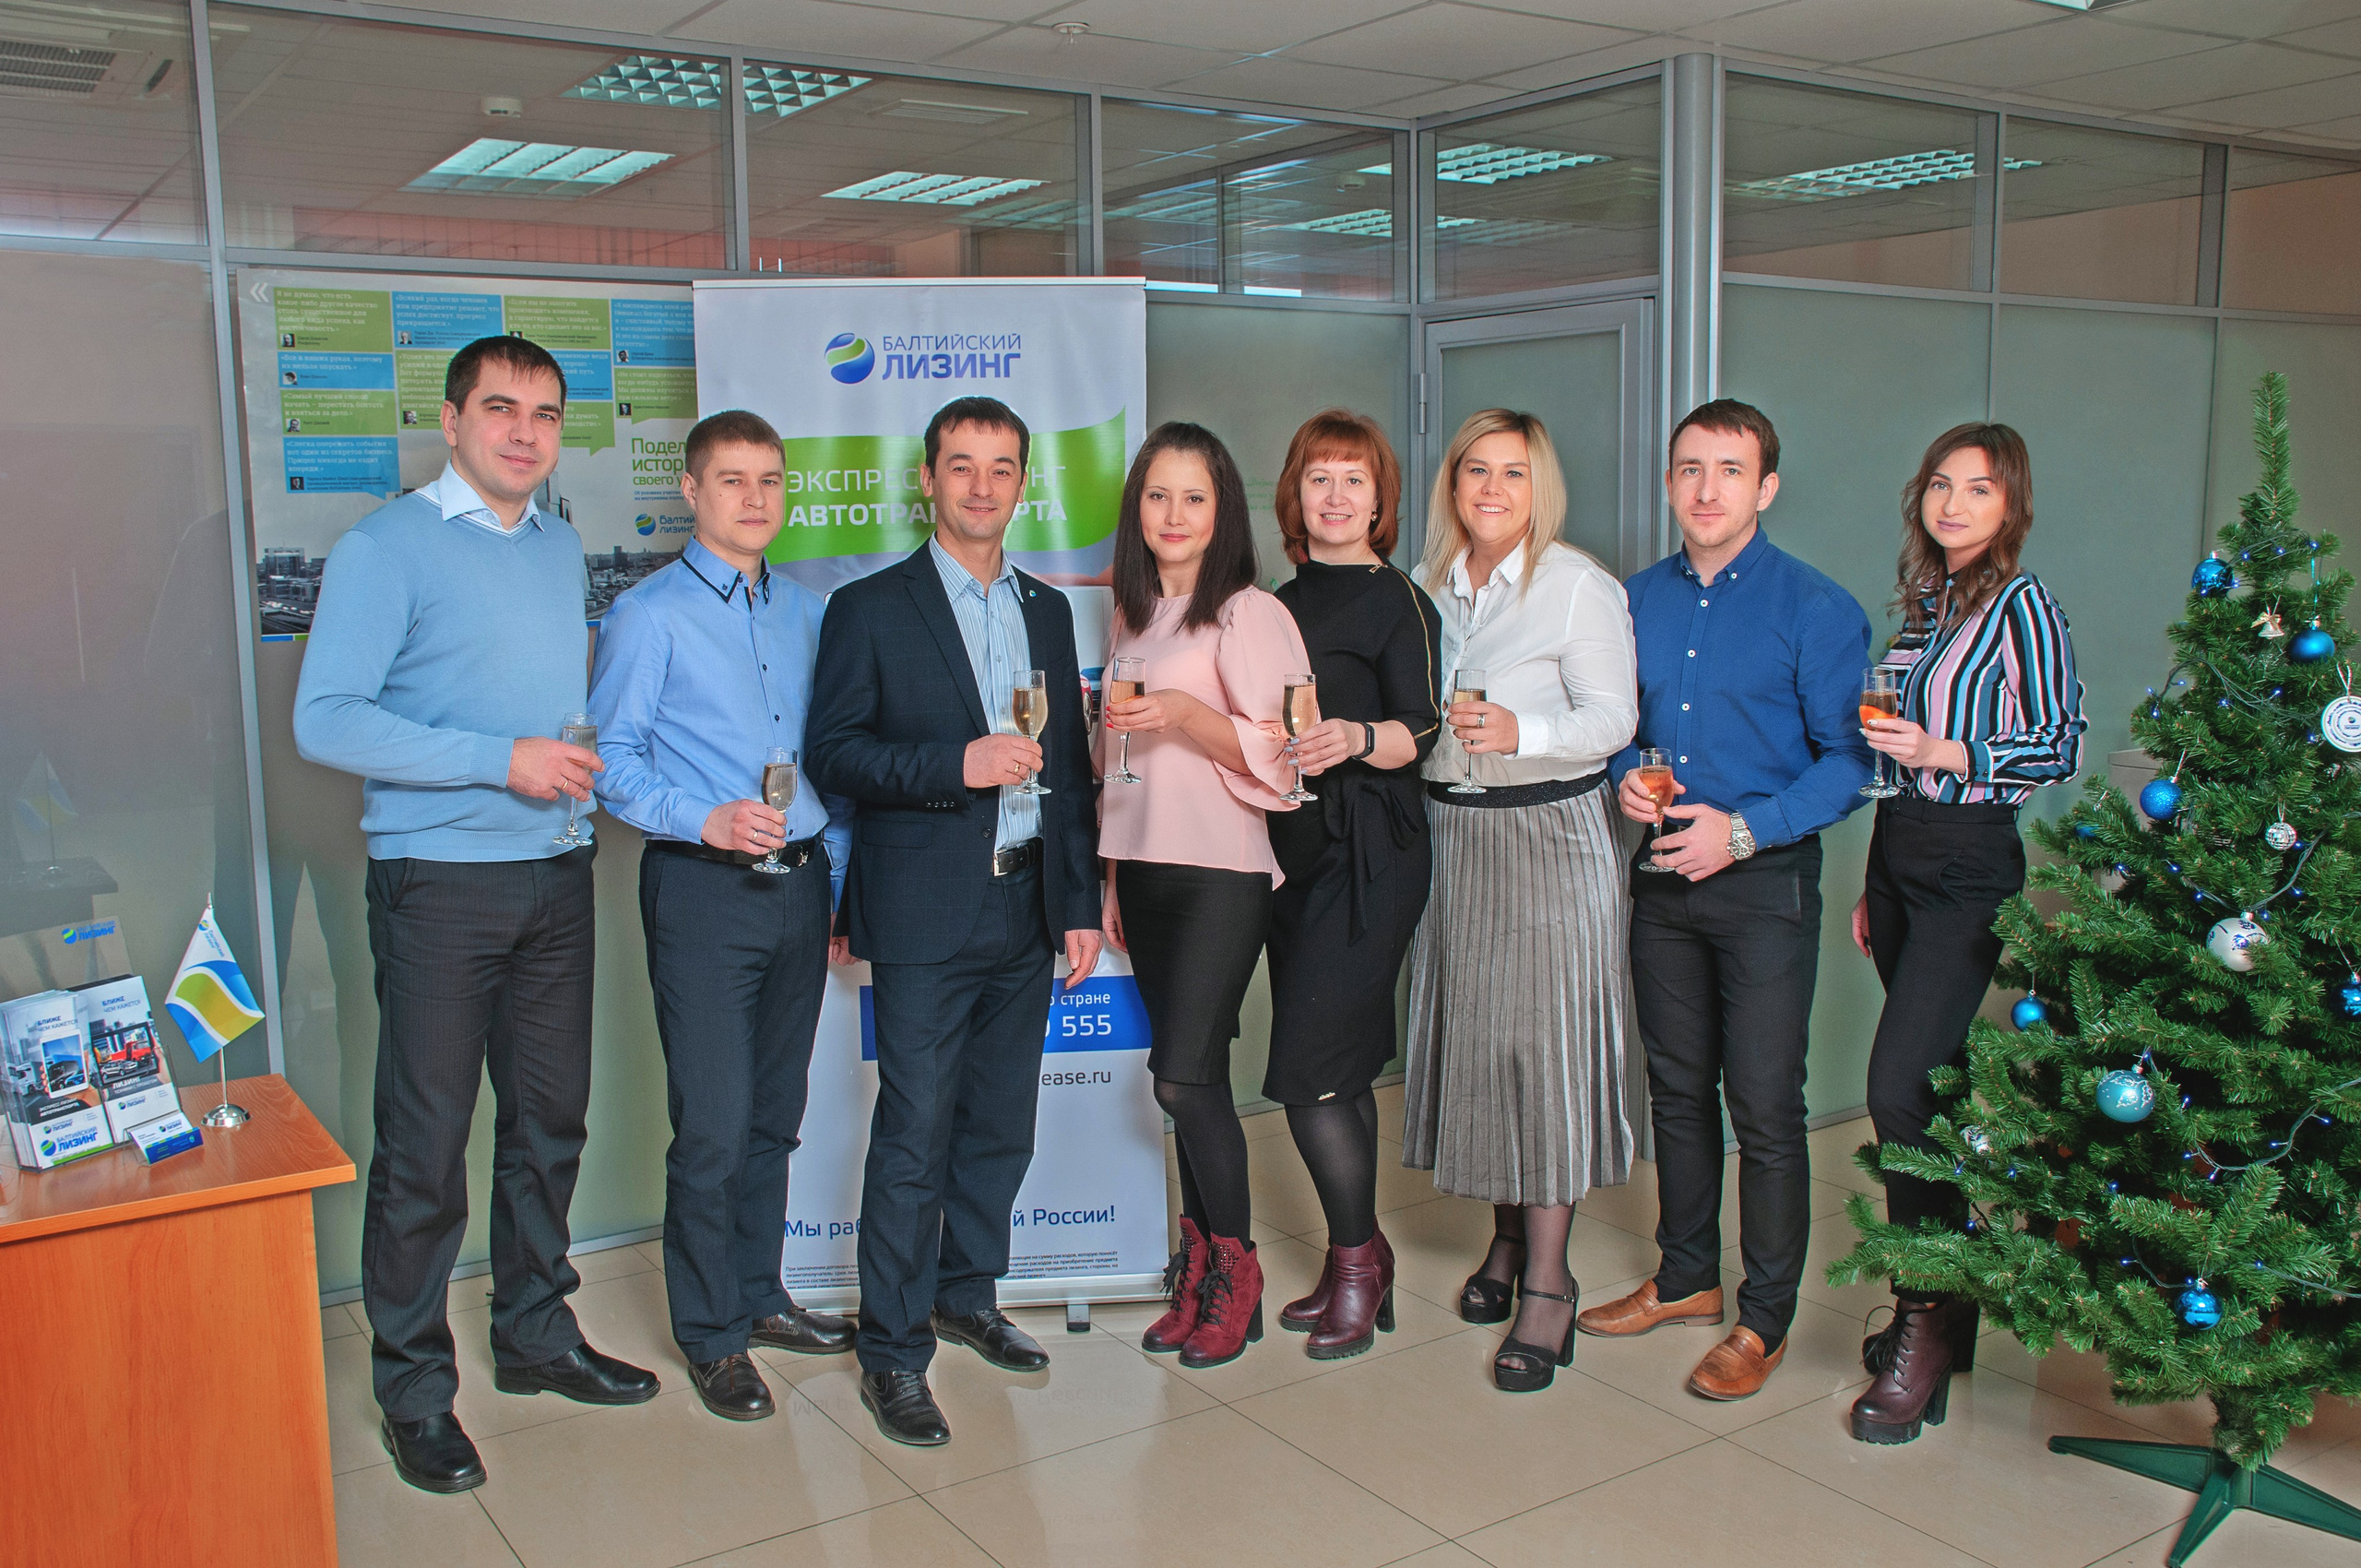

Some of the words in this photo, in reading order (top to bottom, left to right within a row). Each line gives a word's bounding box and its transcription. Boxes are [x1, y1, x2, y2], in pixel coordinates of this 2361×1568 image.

[883, 334, 1021, 351] БАЛТИЙСКИЙ
[882, 353, 1021, 380] ЛИЗИНГ
[632, 458, 683, 475] истор
[633, 476, 673, 485] своего
[79, 925, 115, 941] ЛИЗИНГ
[102, 996, 125, 1006] БЛИЖЕ
[1061, 993, 1111, 1008] стране
[37, 1016, 62, 1025] БЛИЖЕ
[1062, 1014, 1112, 1037] 555
[1041, 1071, 1111, 1085] ease.ru
[59, 1132, 98, 1151] ЛИЗИНГ
[1033, 1205, 1115, 1226] России!
[785, 1220, 821, 1237] Мы
